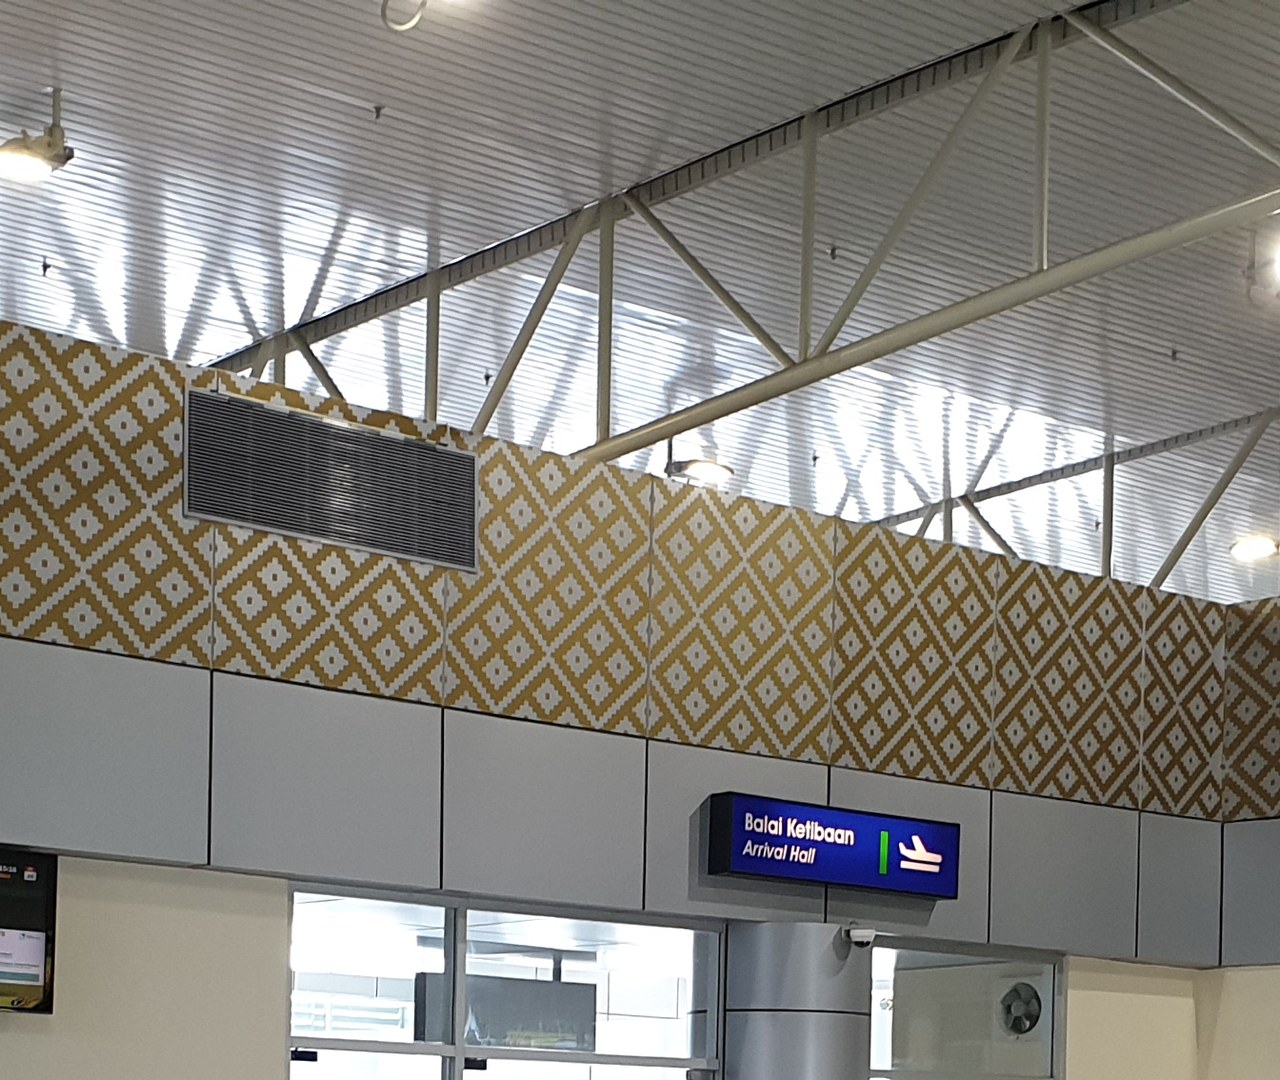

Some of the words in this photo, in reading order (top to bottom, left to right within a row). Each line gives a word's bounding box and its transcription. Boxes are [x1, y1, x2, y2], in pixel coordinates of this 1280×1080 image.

[744, 812, 783, 836] Balai
[786, 818, 855, 847] Ketibaan
[742, 840, 787, 862] Arrival
[789, 847, 816, 865] Hall
